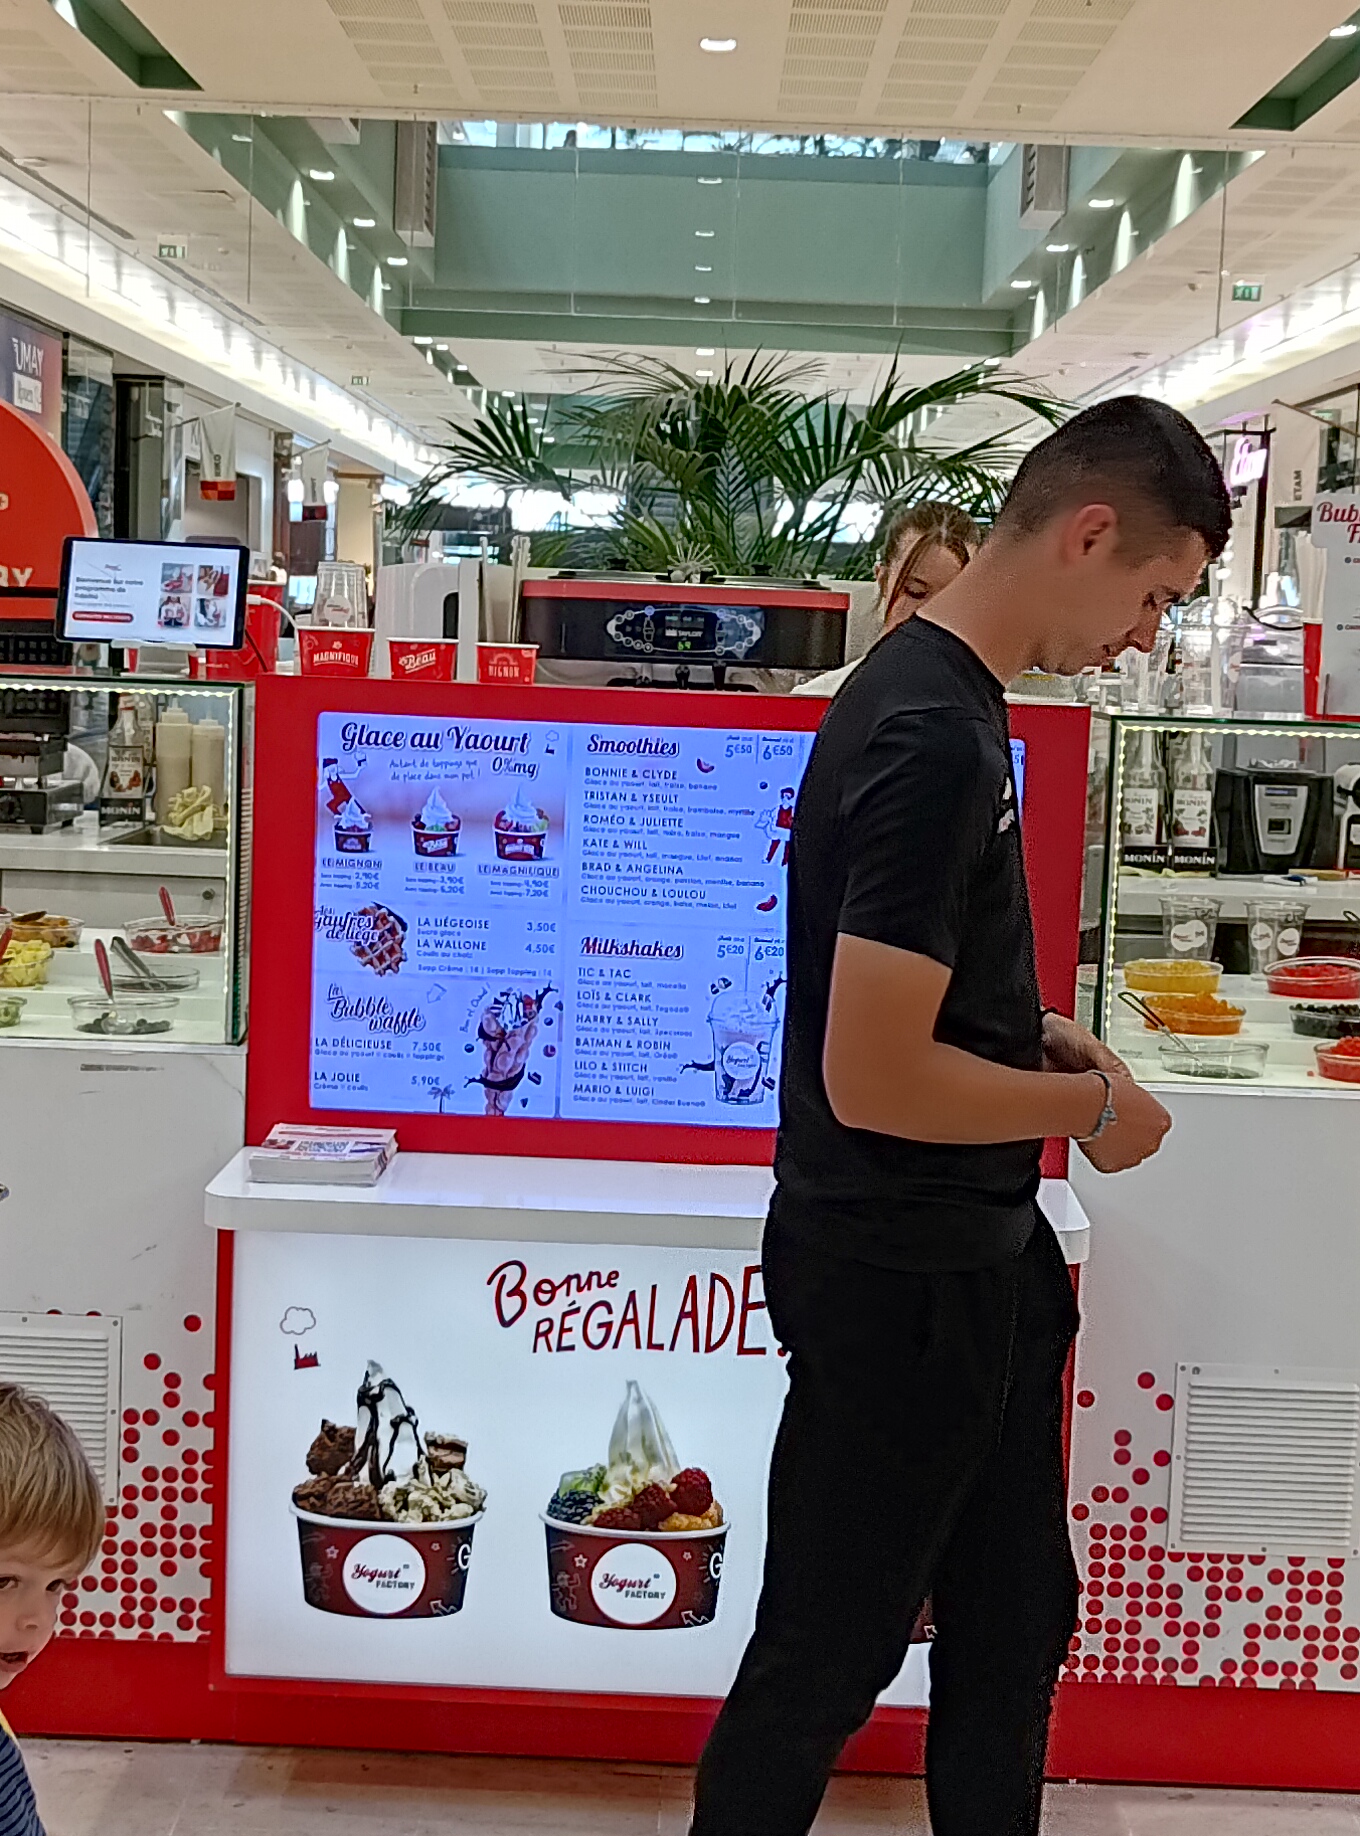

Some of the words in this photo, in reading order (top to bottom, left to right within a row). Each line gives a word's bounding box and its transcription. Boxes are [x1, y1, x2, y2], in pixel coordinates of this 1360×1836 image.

[1293, 470, 1302, 501] ETAM
[405, 651, 437, 669] Beau
[341, 722, 404, 752] Glace
[410, 734, 441, 750] au
[446, 726, 532, 754] Yaourt
[588, 734, 679, 757] Smoothies
[585, 767, 628, 778] BONNIE
[632, 769, 638, 778] &
[642, 769, 677, 780] CLYDE
[584, 791, 627, 801] TRISTAN
[631, 792, 638, 802] &
[642, 793, 678, 804] YSEULT
[583, 814, 625, 825] ROMÉO
[630, 816, 636, 825] &
[640, 816, 684, 827] JULIETTE
[583, 838, 609, 849] KATE
[613, 839, 619, 849] &
[624, 840, 647, 850] WILL
[335, 859, 382, 870] MIGNON
[428, 863, 455, 873] BEAU
[582, 862, 611, 872] BRAD
[615, 863, 622, 873] &
[626, 864, 683, 875] ANGELINA
[581, 885, 647, 897] CHOUCHOU
[651, 888, 658, 898] &
[662, 888, 706, 900] LOULOU
[417, 917, 431, 927] LA
[434, 916, 489, 930] LIÉGEOISE
[417, 939, 431, 949] LA
[434, 939, 487, 951] WALLONE
[581, 936, 683, 960] Milkshakes
[578, 967, 595, 977] TIC
[599, 968, 605, 978] &
[610, 968, 632, 978] TAC
[577, 989, 600, 1001] LOÏS
[604, 992, 611, 1001] &
[615, 992, 651, 1002] CLARK
[330, 996, 392, 1019] Bubble
[368, 1007, 425, 1035] waffle
[576, 1014, 612, 1025] HARRY
[616, 1016, 623, 1025] &
[627, 1016, 658, 1027] SALLY
[315, 1037, 328, 1047] LA
[332, 1036, 392, 1050] DÉLICIEUSE
[575, 1038, 622, 1049] BATMAN
[626, 1039, 632, 1049] &
[636, 1040, 670, 1051] ROBIN
[574, 1061, 597, 1071] LILO
[601, 1062, 607, 1072] &
[611, 1062, 647, 1073] STITCH
[314, 1072, 327, 1082] LA
[331, 1073, 360, 1083] JOLIE
[573, 1084, 611, 1095] MARIO
[615, 1085, 622, 1095] &
[626, 1086, 654, 1097] LUIGI
[487, 1259, 620, 1328] Bonne
[533, 1265, 768, 1357] RÉGALADE
[351, 1563, 401, 1586] Yogurt
[375, 1580, 415, 1590] FACTORY
[598, 1572, 652, 1595] Yogurt
[625, 1591, 666, 1600] FACTORY
